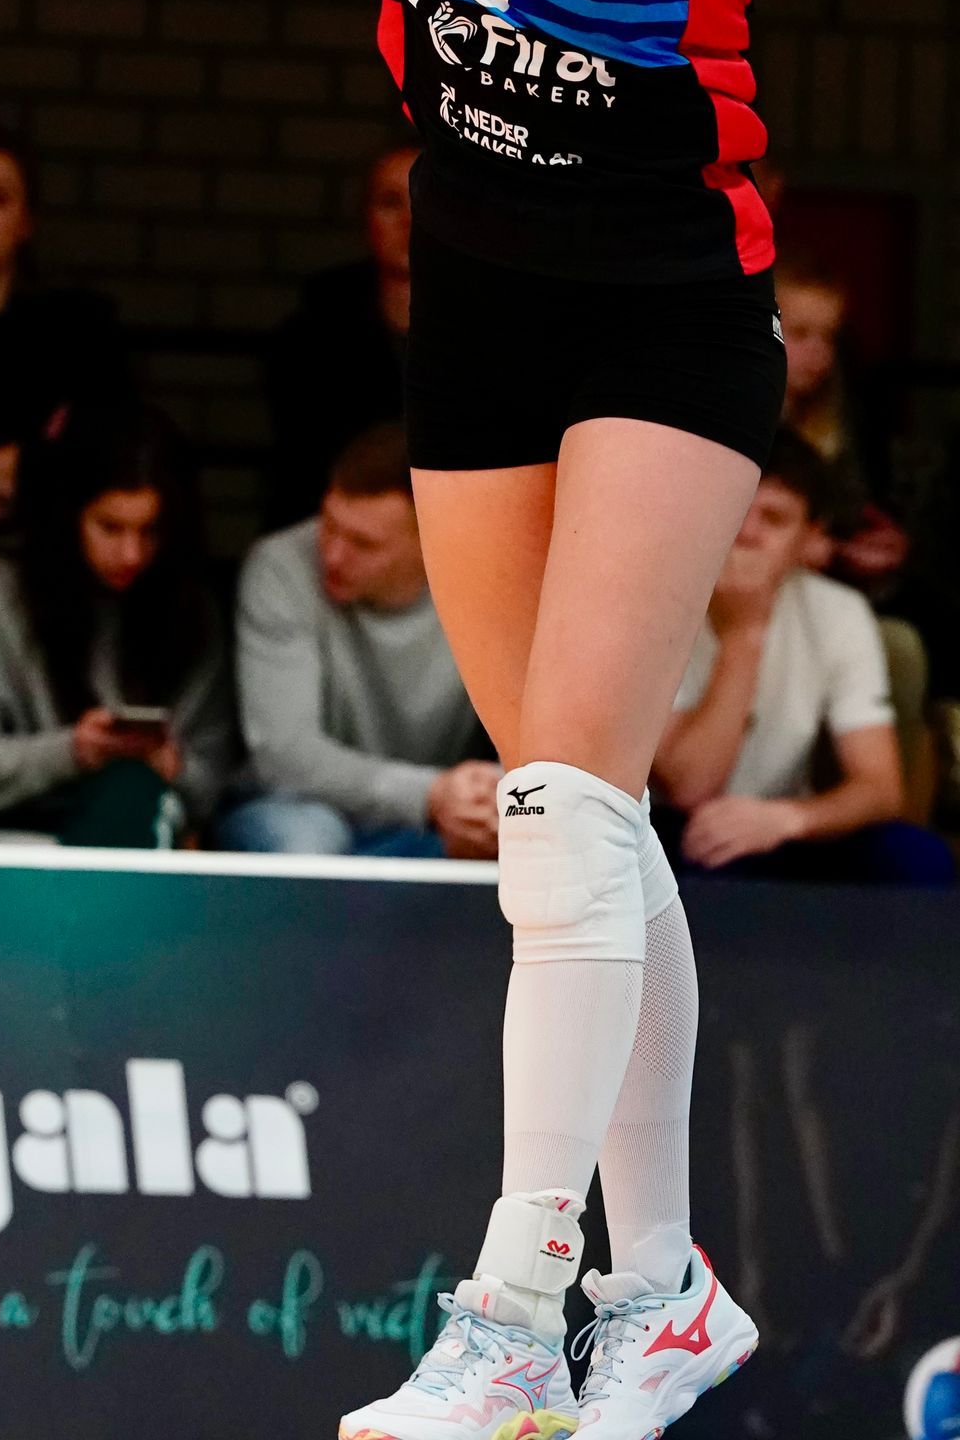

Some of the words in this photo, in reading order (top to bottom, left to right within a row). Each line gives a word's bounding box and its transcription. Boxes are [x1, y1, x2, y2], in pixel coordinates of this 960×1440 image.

[480, 71, 616, 108] BAKERY
[464, 104, 529, 148] NEDER
[47, 1244, 226, 1370] touch
[248, 1250, 323, 1360] of
